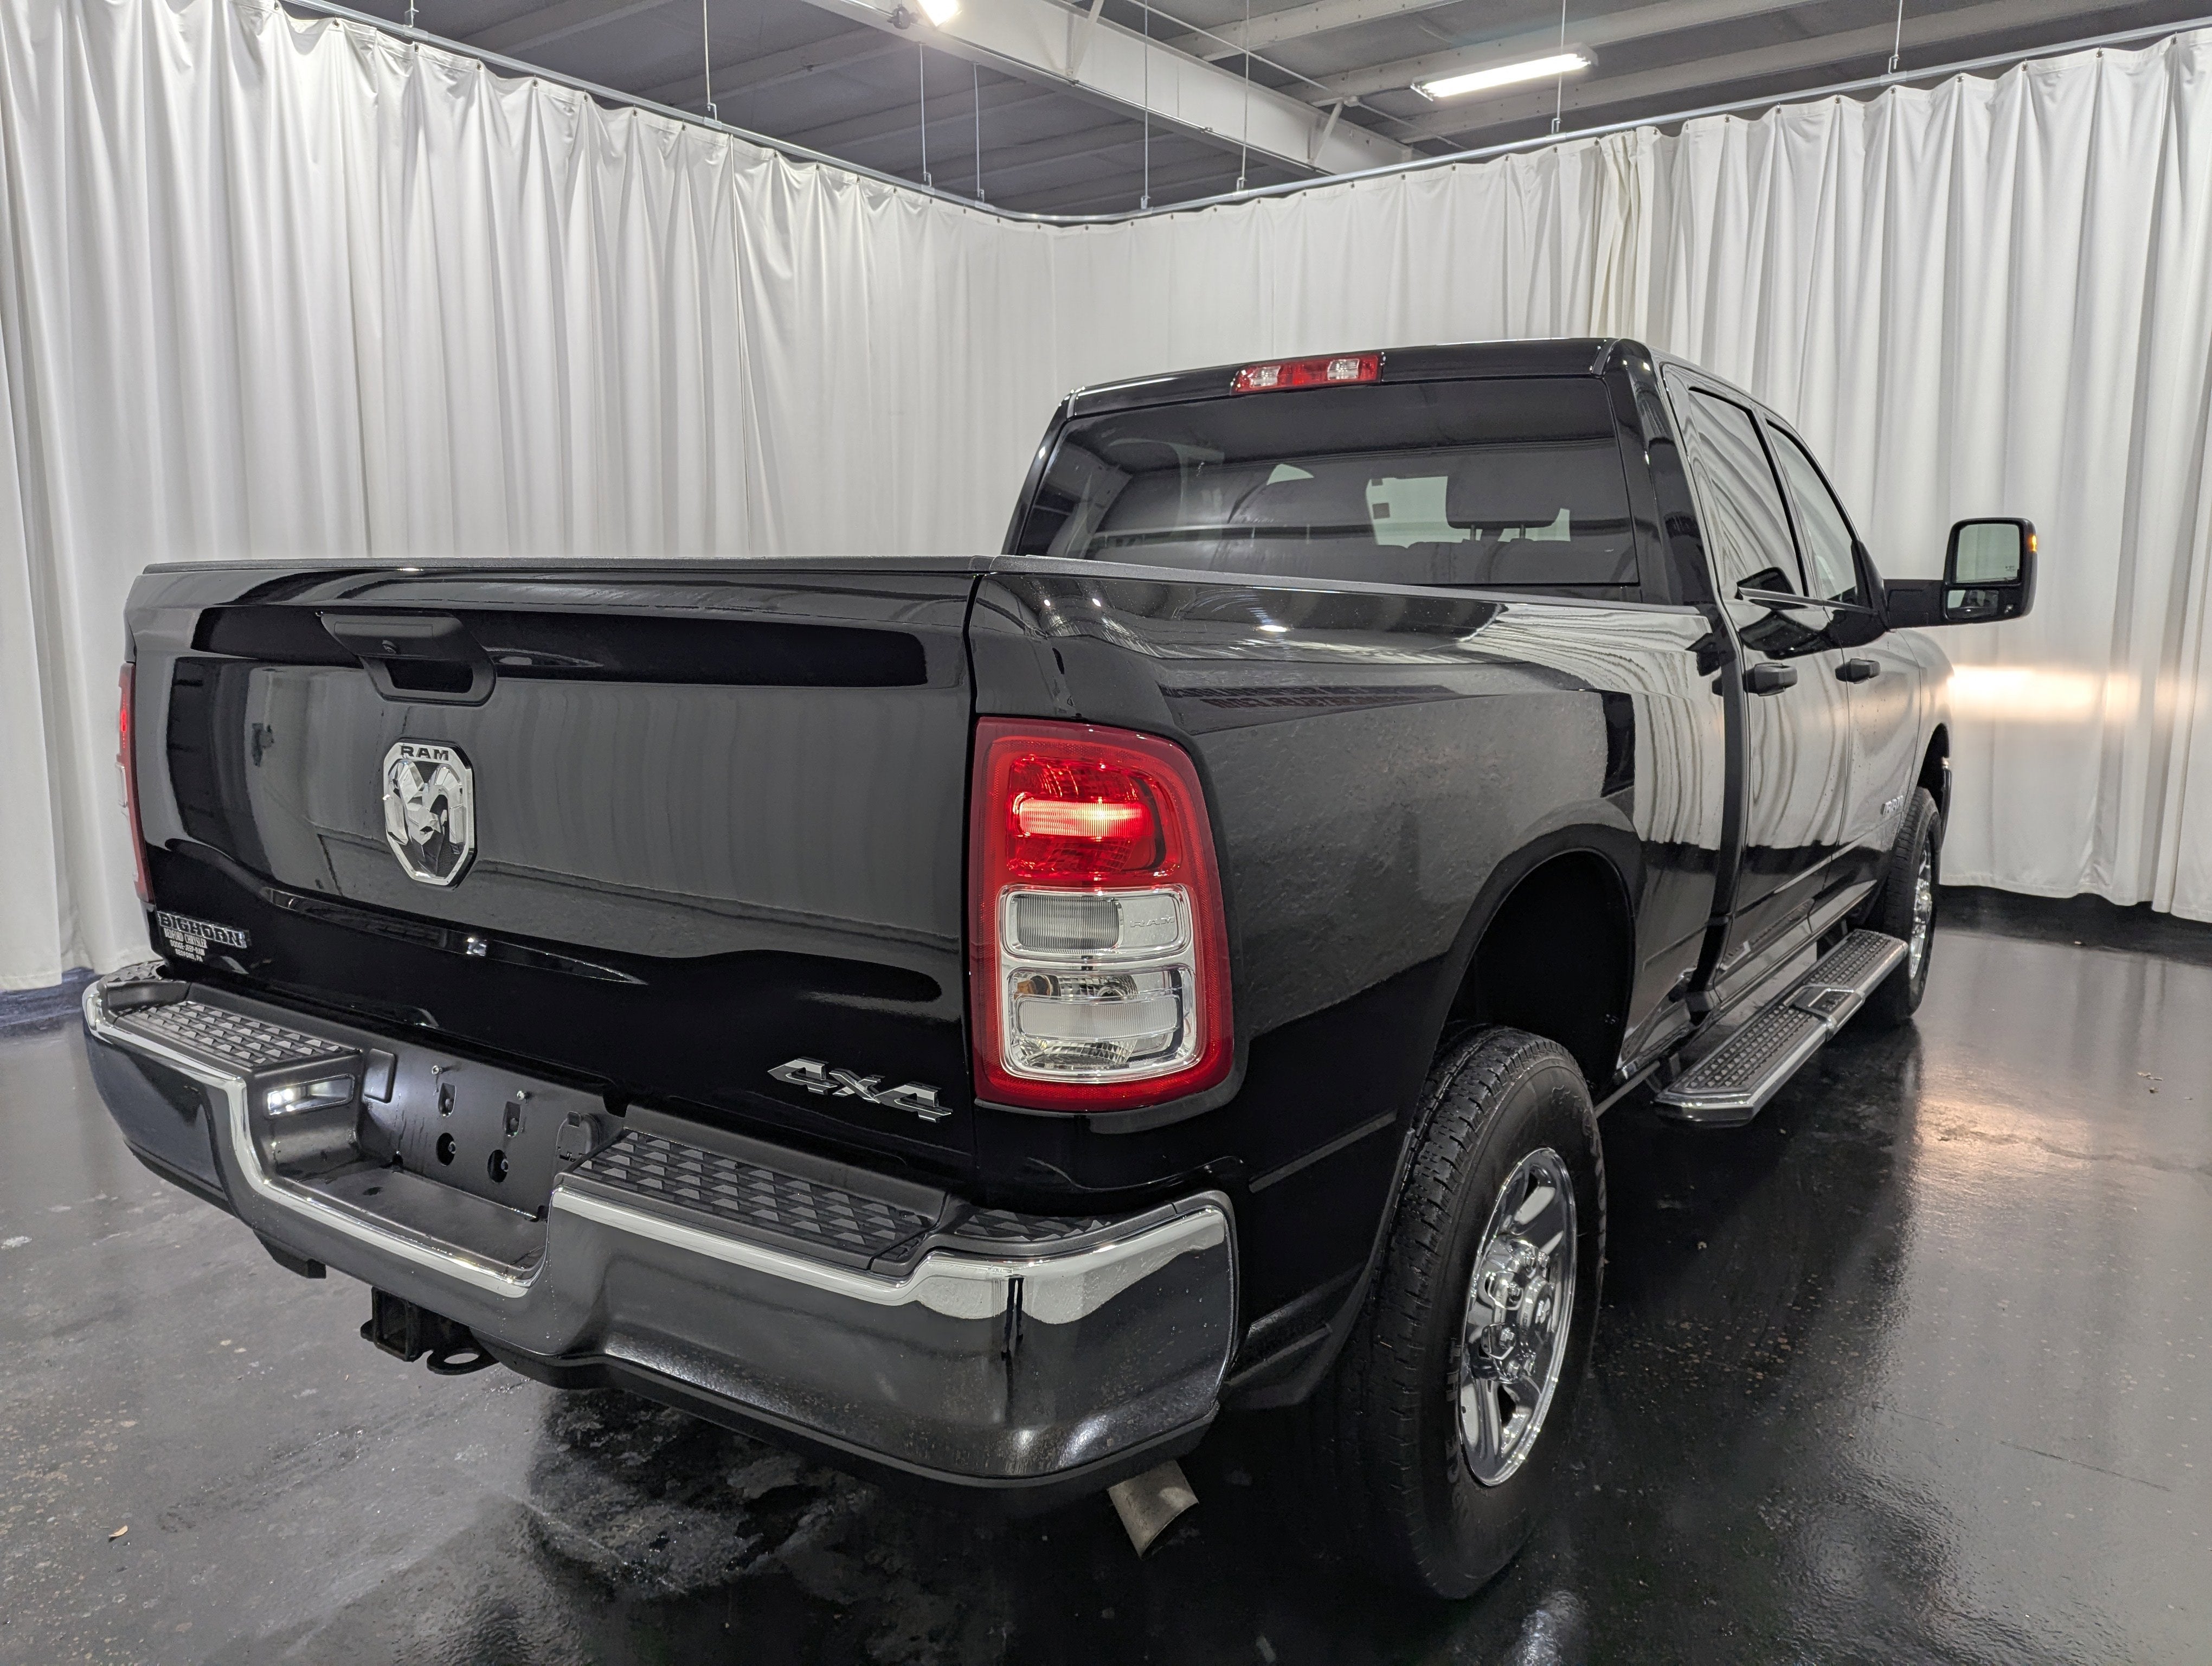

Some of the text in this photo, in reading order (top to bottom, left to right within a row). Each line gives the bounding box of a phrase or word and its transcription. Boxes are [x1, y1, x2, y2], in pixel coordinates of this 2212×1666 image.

[400, 745, 449, 761] RAM
[1130, 916, 1175, 928] RAM
[184, 933, 208, 949] CHRYSLER
